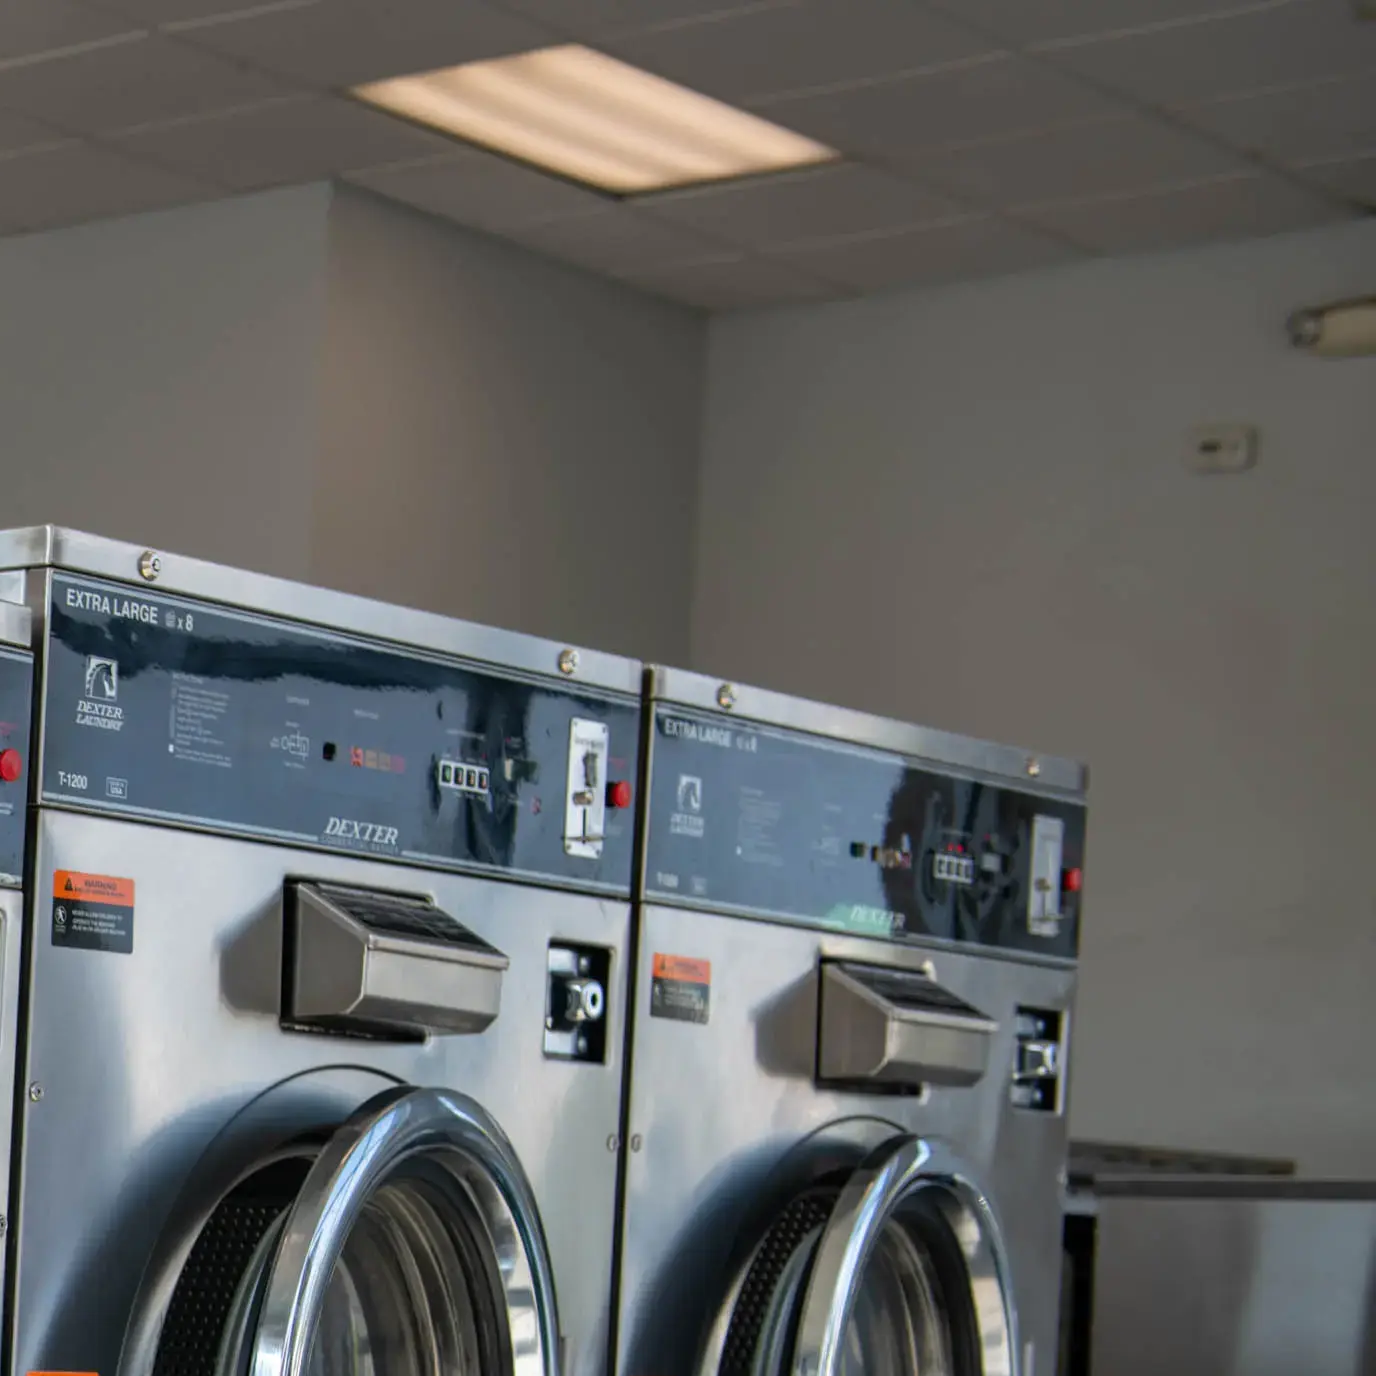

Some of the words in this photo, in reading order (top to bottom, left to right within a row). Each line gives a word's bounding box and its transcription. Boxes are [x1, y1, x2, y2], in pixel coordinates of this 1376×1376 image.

[66, 588, 111, 614] EXTRA
[113, 598, 159, 625] LARGE
[177, 619, 184, 630] x
[185, 614, 194, 632] 8
[76, 714, 124, 731] LAUNDRY
[665, 718, 698, 739] EXTRA
[699, 726, 732, 747] LARGE
[58, 771, 88, 790] T-1200
[323, 817, 398, 845] DEXTER
